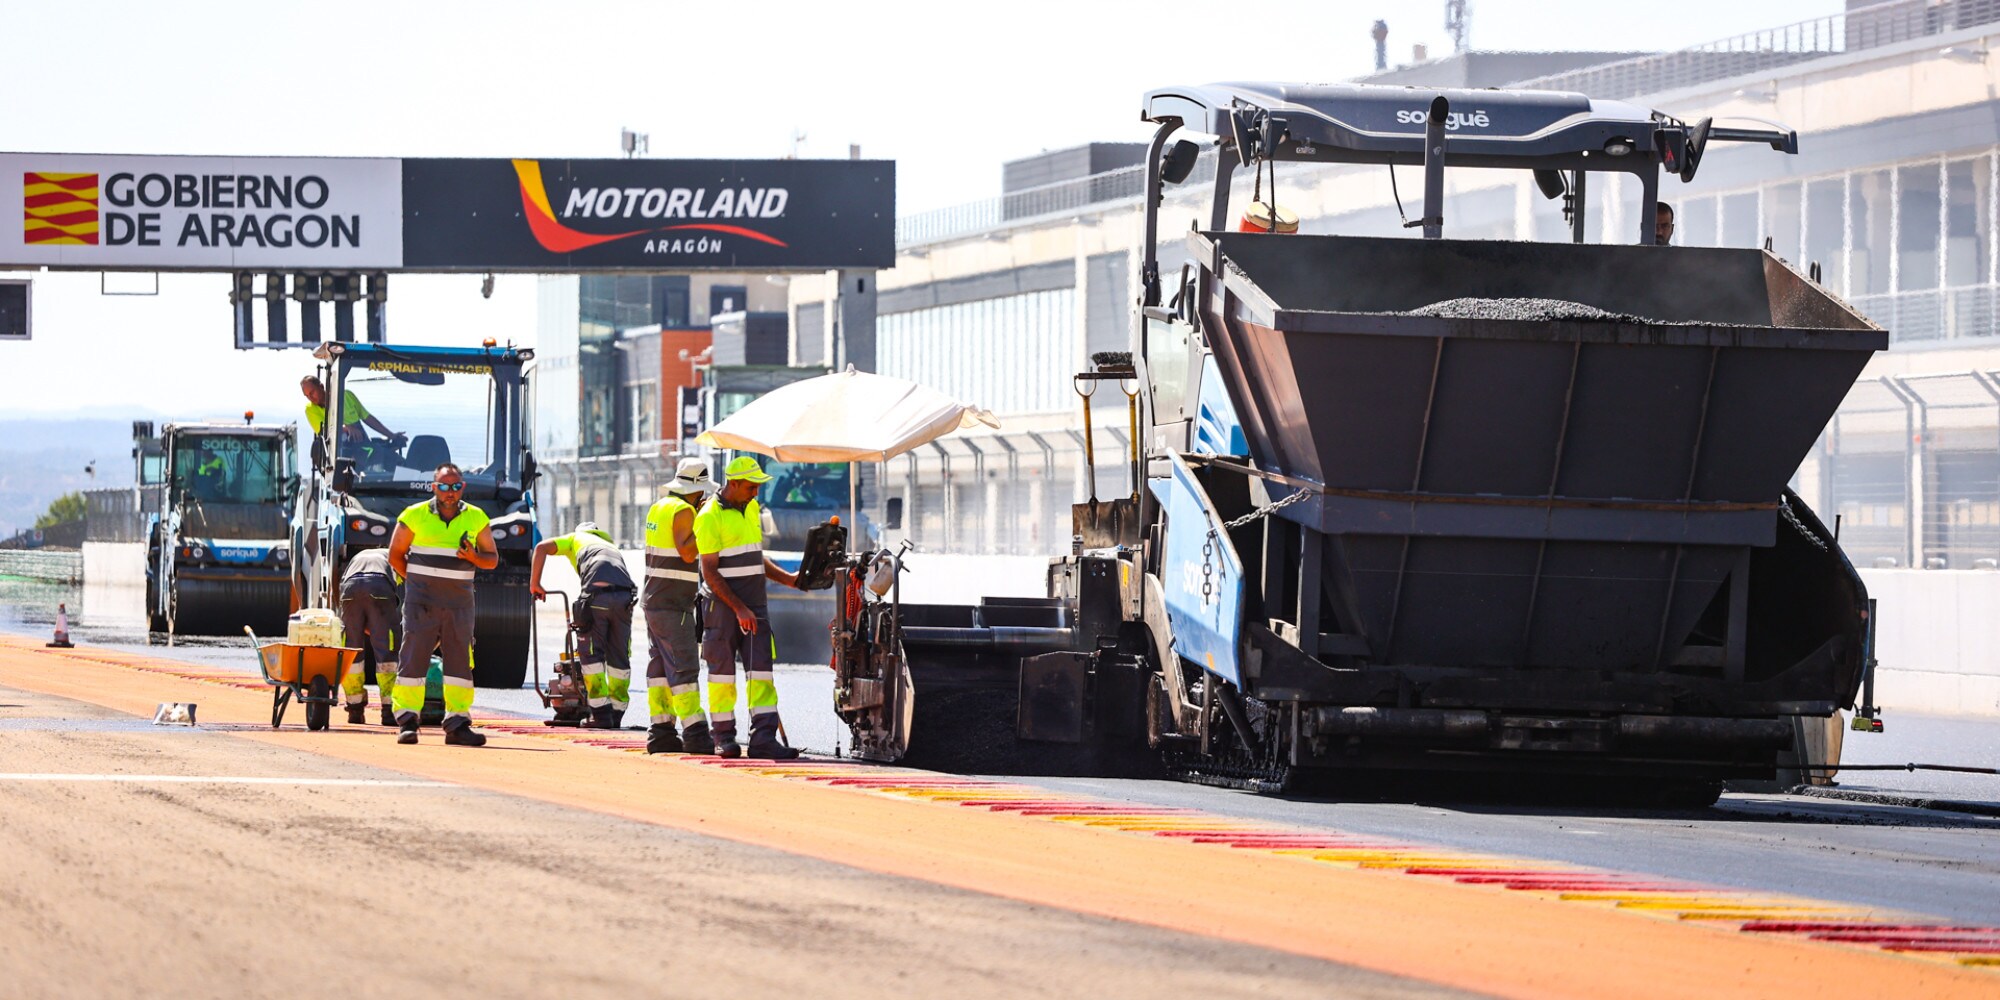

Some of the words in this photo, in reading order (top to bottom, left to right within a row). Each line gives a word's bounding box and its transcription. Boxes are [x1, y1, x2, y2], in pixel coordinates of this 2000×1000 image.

[105, 172, 329, 209] GOBIERNO
[563, 187, 788, 218] MOTORLAND
[106, 213, 161, 246] DE
[177, 214, 360, 248] ARAGON
[644, 236, 722, 253] ARAGÓN
[369, 361, 423, 374] ASPHALT
[428, 363, 493, 375] MANAGER
[410, 480, 433, 492] sorig
